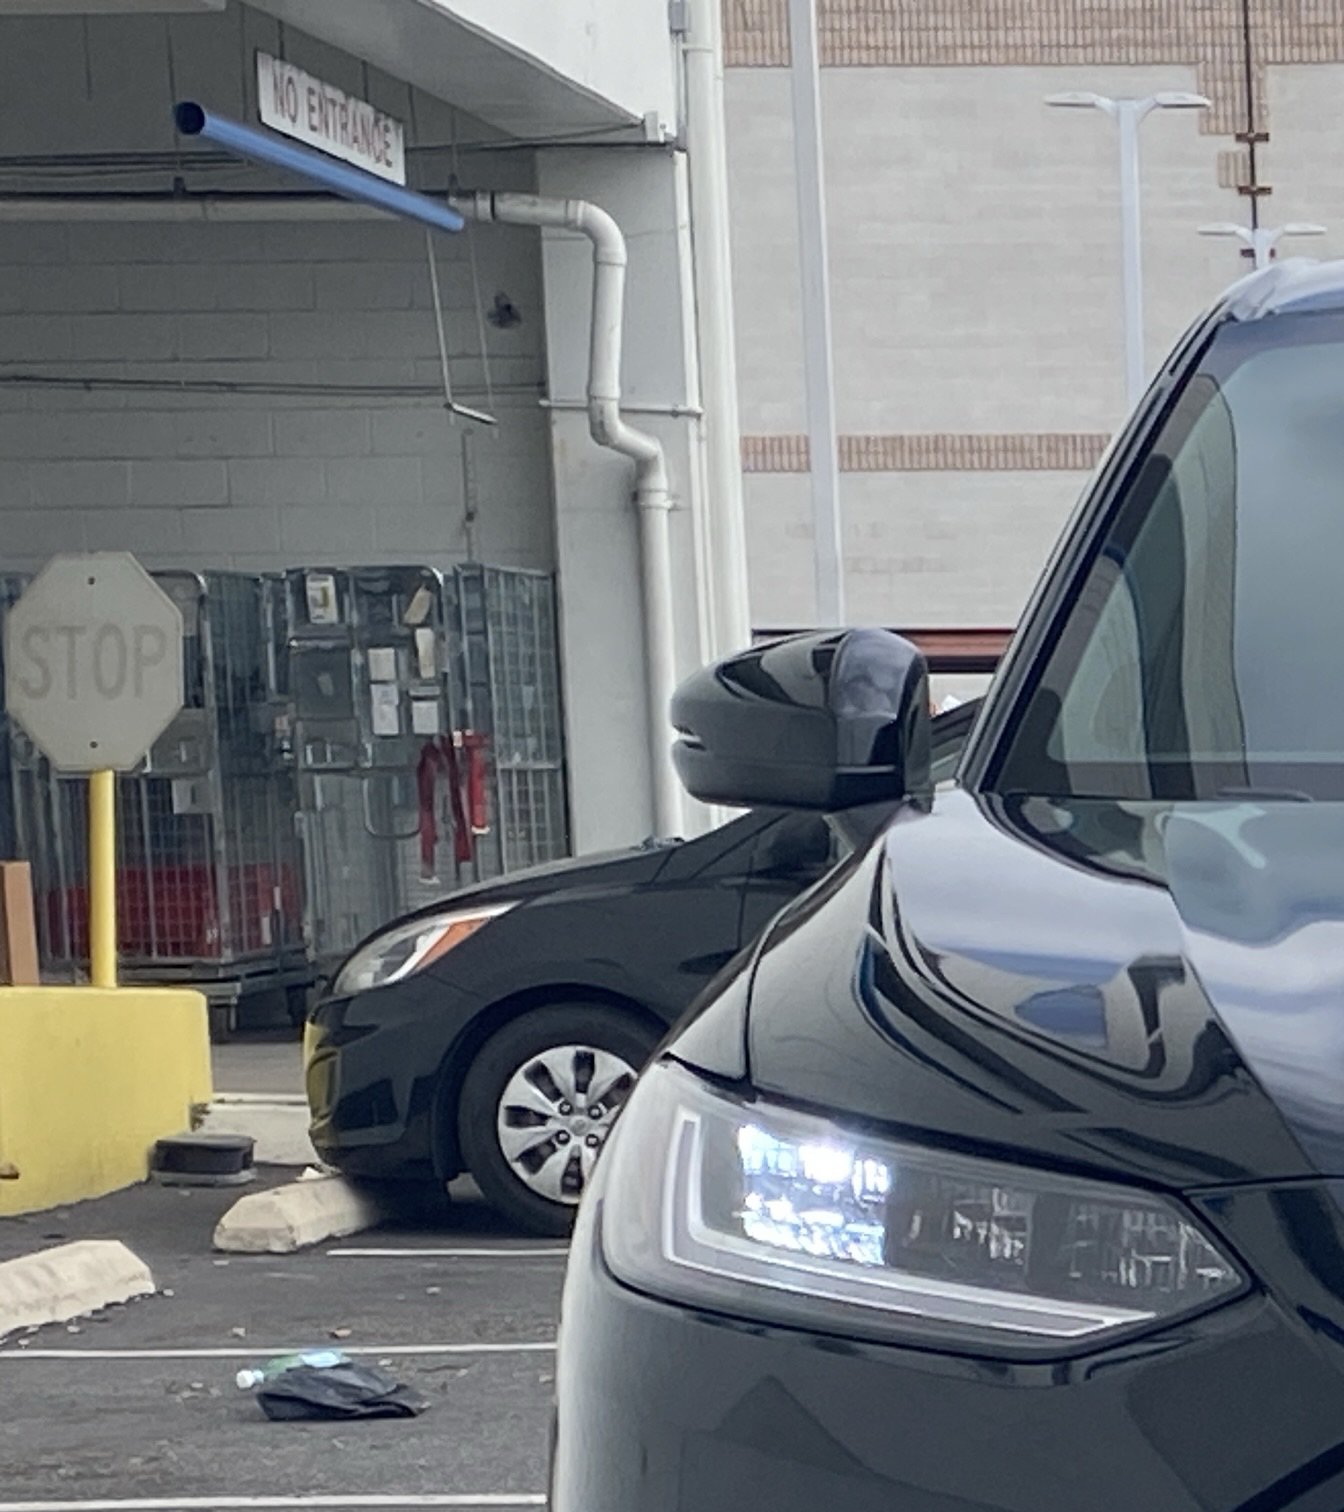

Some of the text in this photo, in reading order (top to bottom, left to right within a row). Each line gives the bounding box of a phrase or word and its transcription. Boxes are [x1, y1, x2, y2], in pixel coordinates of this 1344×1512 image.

[273, 71, 393, 168] NO ENTRANCE
[18, 625, 167, 701] STOP
